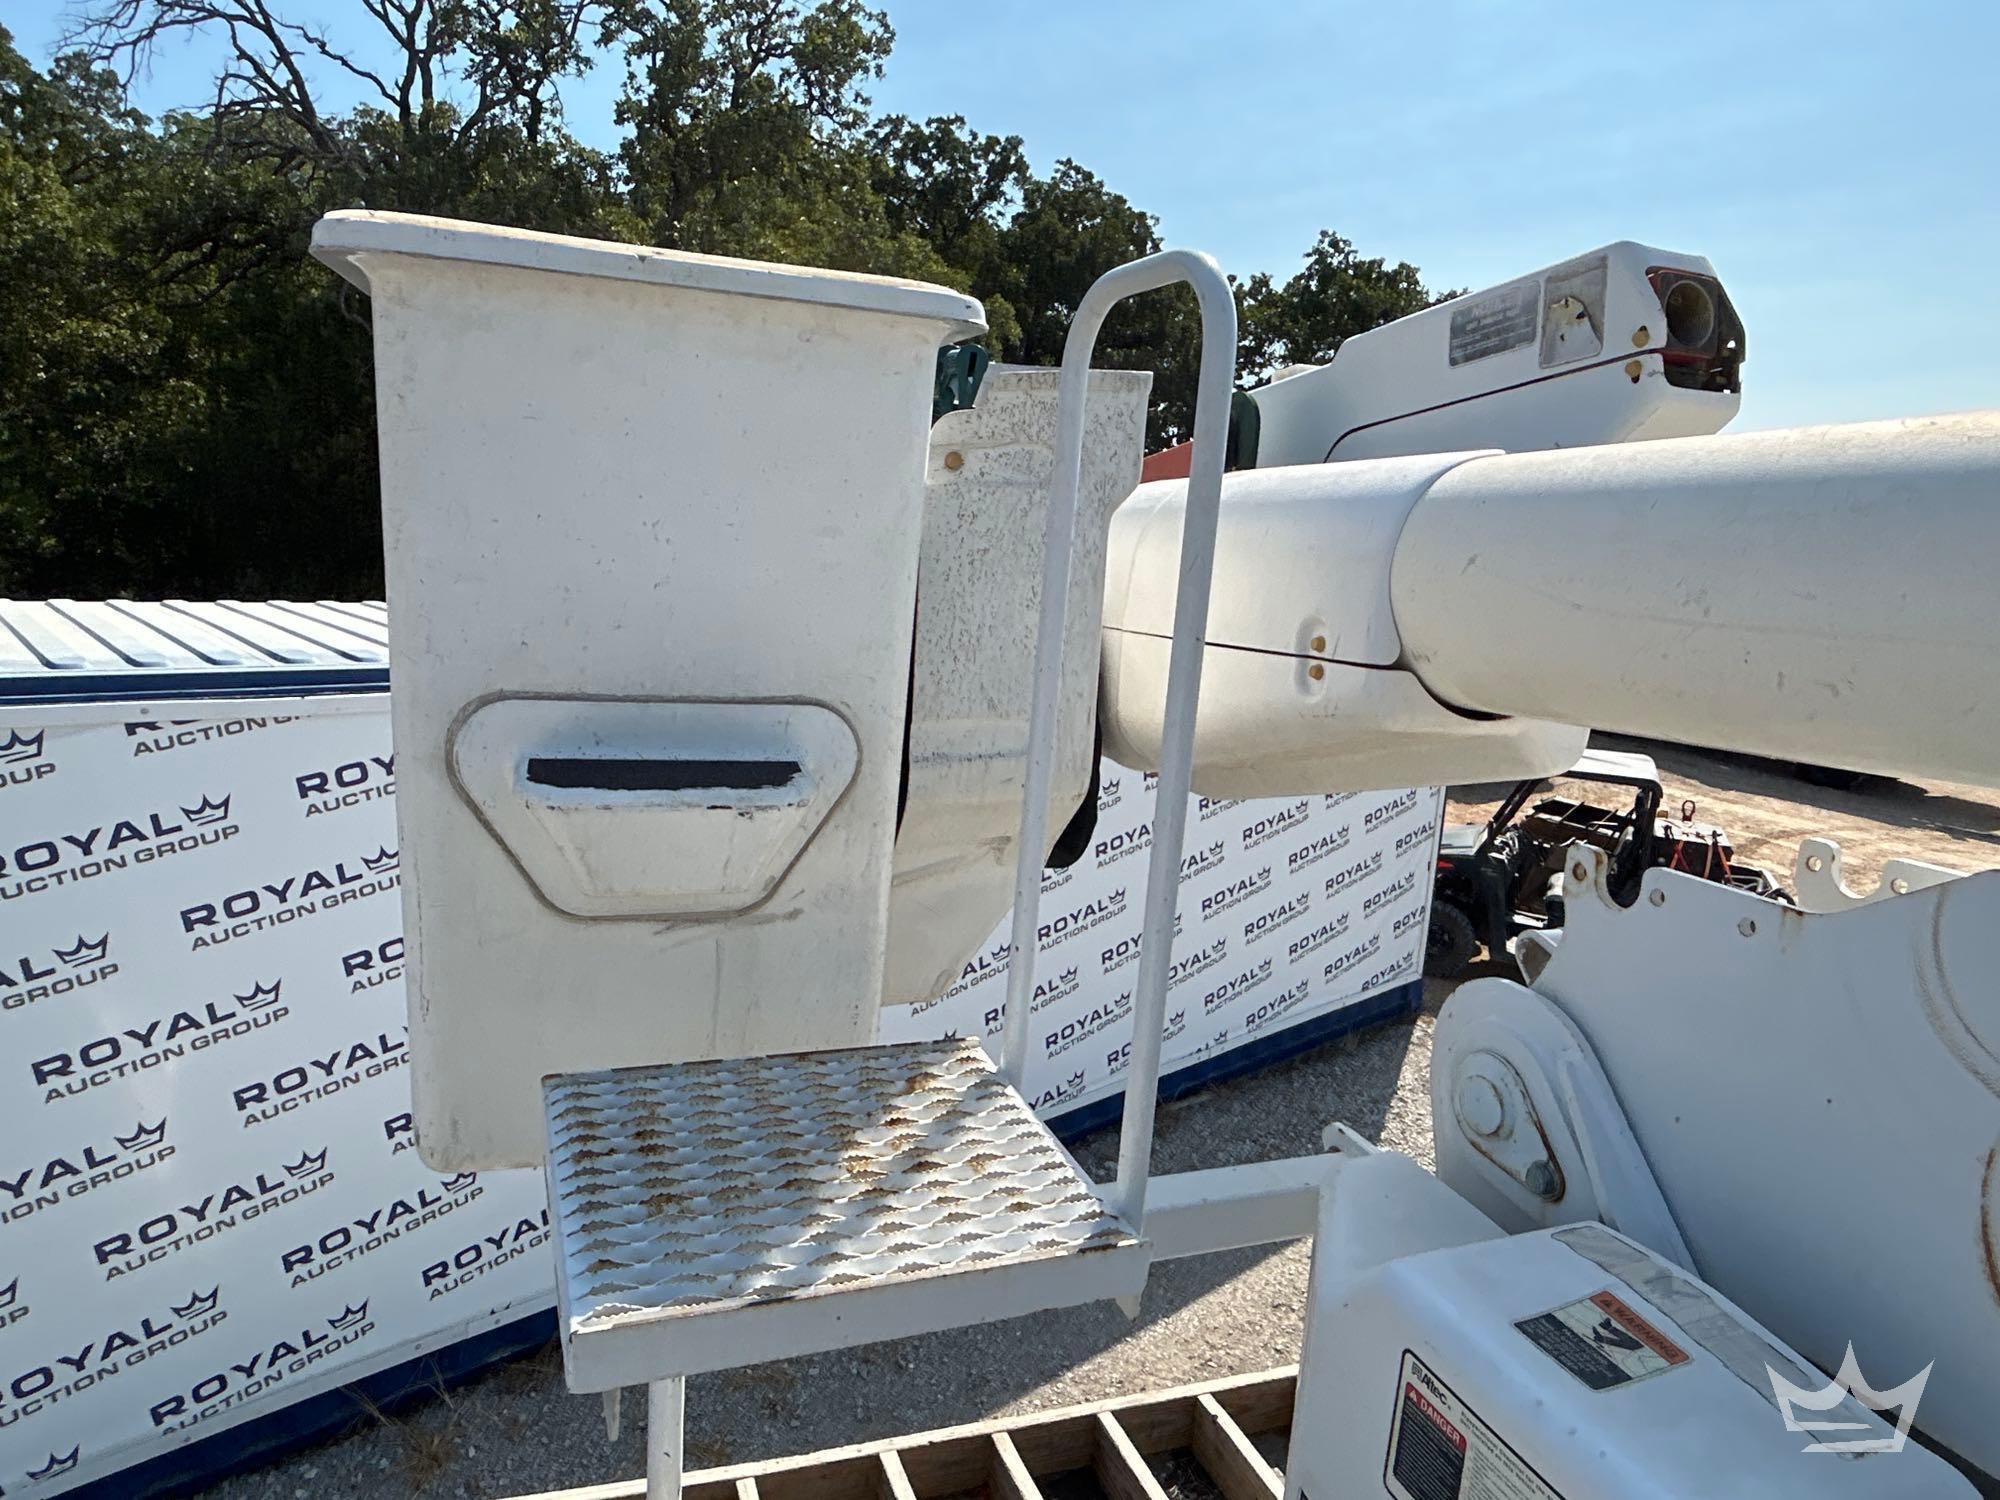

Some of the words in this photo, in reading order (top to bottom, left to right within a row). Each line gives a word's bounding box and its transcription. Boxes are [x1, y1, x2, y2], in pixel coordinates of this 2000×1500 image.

[134, 717, 266, 757] AUCTION
[1242, 807, 1296, 842] ROYAL
[1364, 795, 1407, 826] ROYAL
[134, 824, 239, 863] GROUP
[1097, 843, 1143, 869] AUCTION
[1244, 828, 1281, 851] AUCTION
[1288, 833, 1338, 867] ROYAL
[1395, 821, 1435, 851] ROYAL
[1192, 856, 1225, 877] GROUP
[1289, 852, 1323, 875] AUCTION
[1325, 859, 1371, 892] ROYAL
[180, 862, 363, 933] ROYAL
[191, 901, 316, 951] AUCTION
[322, 873, 401, 908] GROU
[1202, 875, 1257, 912] ROYAL
[1203, 895, 1242, 922] AUCTION
[1242, 880, 1272, 900] GROUP
[1363, 880, 1405, 912] ROYAL
[1037, 899, 1108, 942] ROYAL
[1040, 923, 1088, 952] AUCTION
[1090, 904, 1127, 928] GROUP
[1244, 901, 1296, 937] ROYAL
[1245, 922, 1281, 946] AUCTION
[1288, 922, 1337, 956] ROYAL
[1101, 933, 1142, 965] ROY
[1195, 951, 1227, 975] GROUP
[1323, 943, 1369, 977] ROYAL
[3, 963, 119, 1010] GROUP
[1040, 982, 1080, 1008] GROUP
[1204, 968, 1258, 1008] ROYAL
[1361, 960, 1403, 992] ROYAL
[1205, 990, 1243, 1016] AUCTION
[1245, 988, 1296, 1028] ROYAL
[31, 1002, 237, 1086] ROYAL
[1045, 1004, 1114, 1050] ROYAL
[1047, 1029, 1095, 1060] AUCTION
[1096, 1006, 1132, 1032] GROUP
[44, 1043, 185, 1104] AUCTION
[190, 1006, 290, 1050] GROUP
[233, 1033, 404, 1111] ROYAL
[243, 1071, 360, 1128] AUCTION
[67, 1145, 176, 1197] GROUP
[94, 1174, 285, 1264] ROYAL
[106, 1215, 235, 1281] AUCTION
[241, 1172, 335, 1221] GROUP
[281, 1189, 442, 1273] ROYAL
[291, 1227, 400, 1288] AUCTION
[405, 1186, 484, 1232] GROUP
[430, 1243, 525, 1301] AUCTION
[126, 1310, 228, 1366] GROUP
[1615, 1307, 1679, 1359] WARNING
[0, 1318, 173, 1410] OYAL
[149, 1329, 328, 1427] ROYAL
[161, 1369, 283, 1436] AUCTION
[288, 1321, 375, 1374] GROUP
[1421, 1373, 1448, 1406] Altec
[1420, 1400, 1461, 1447] DANGER
